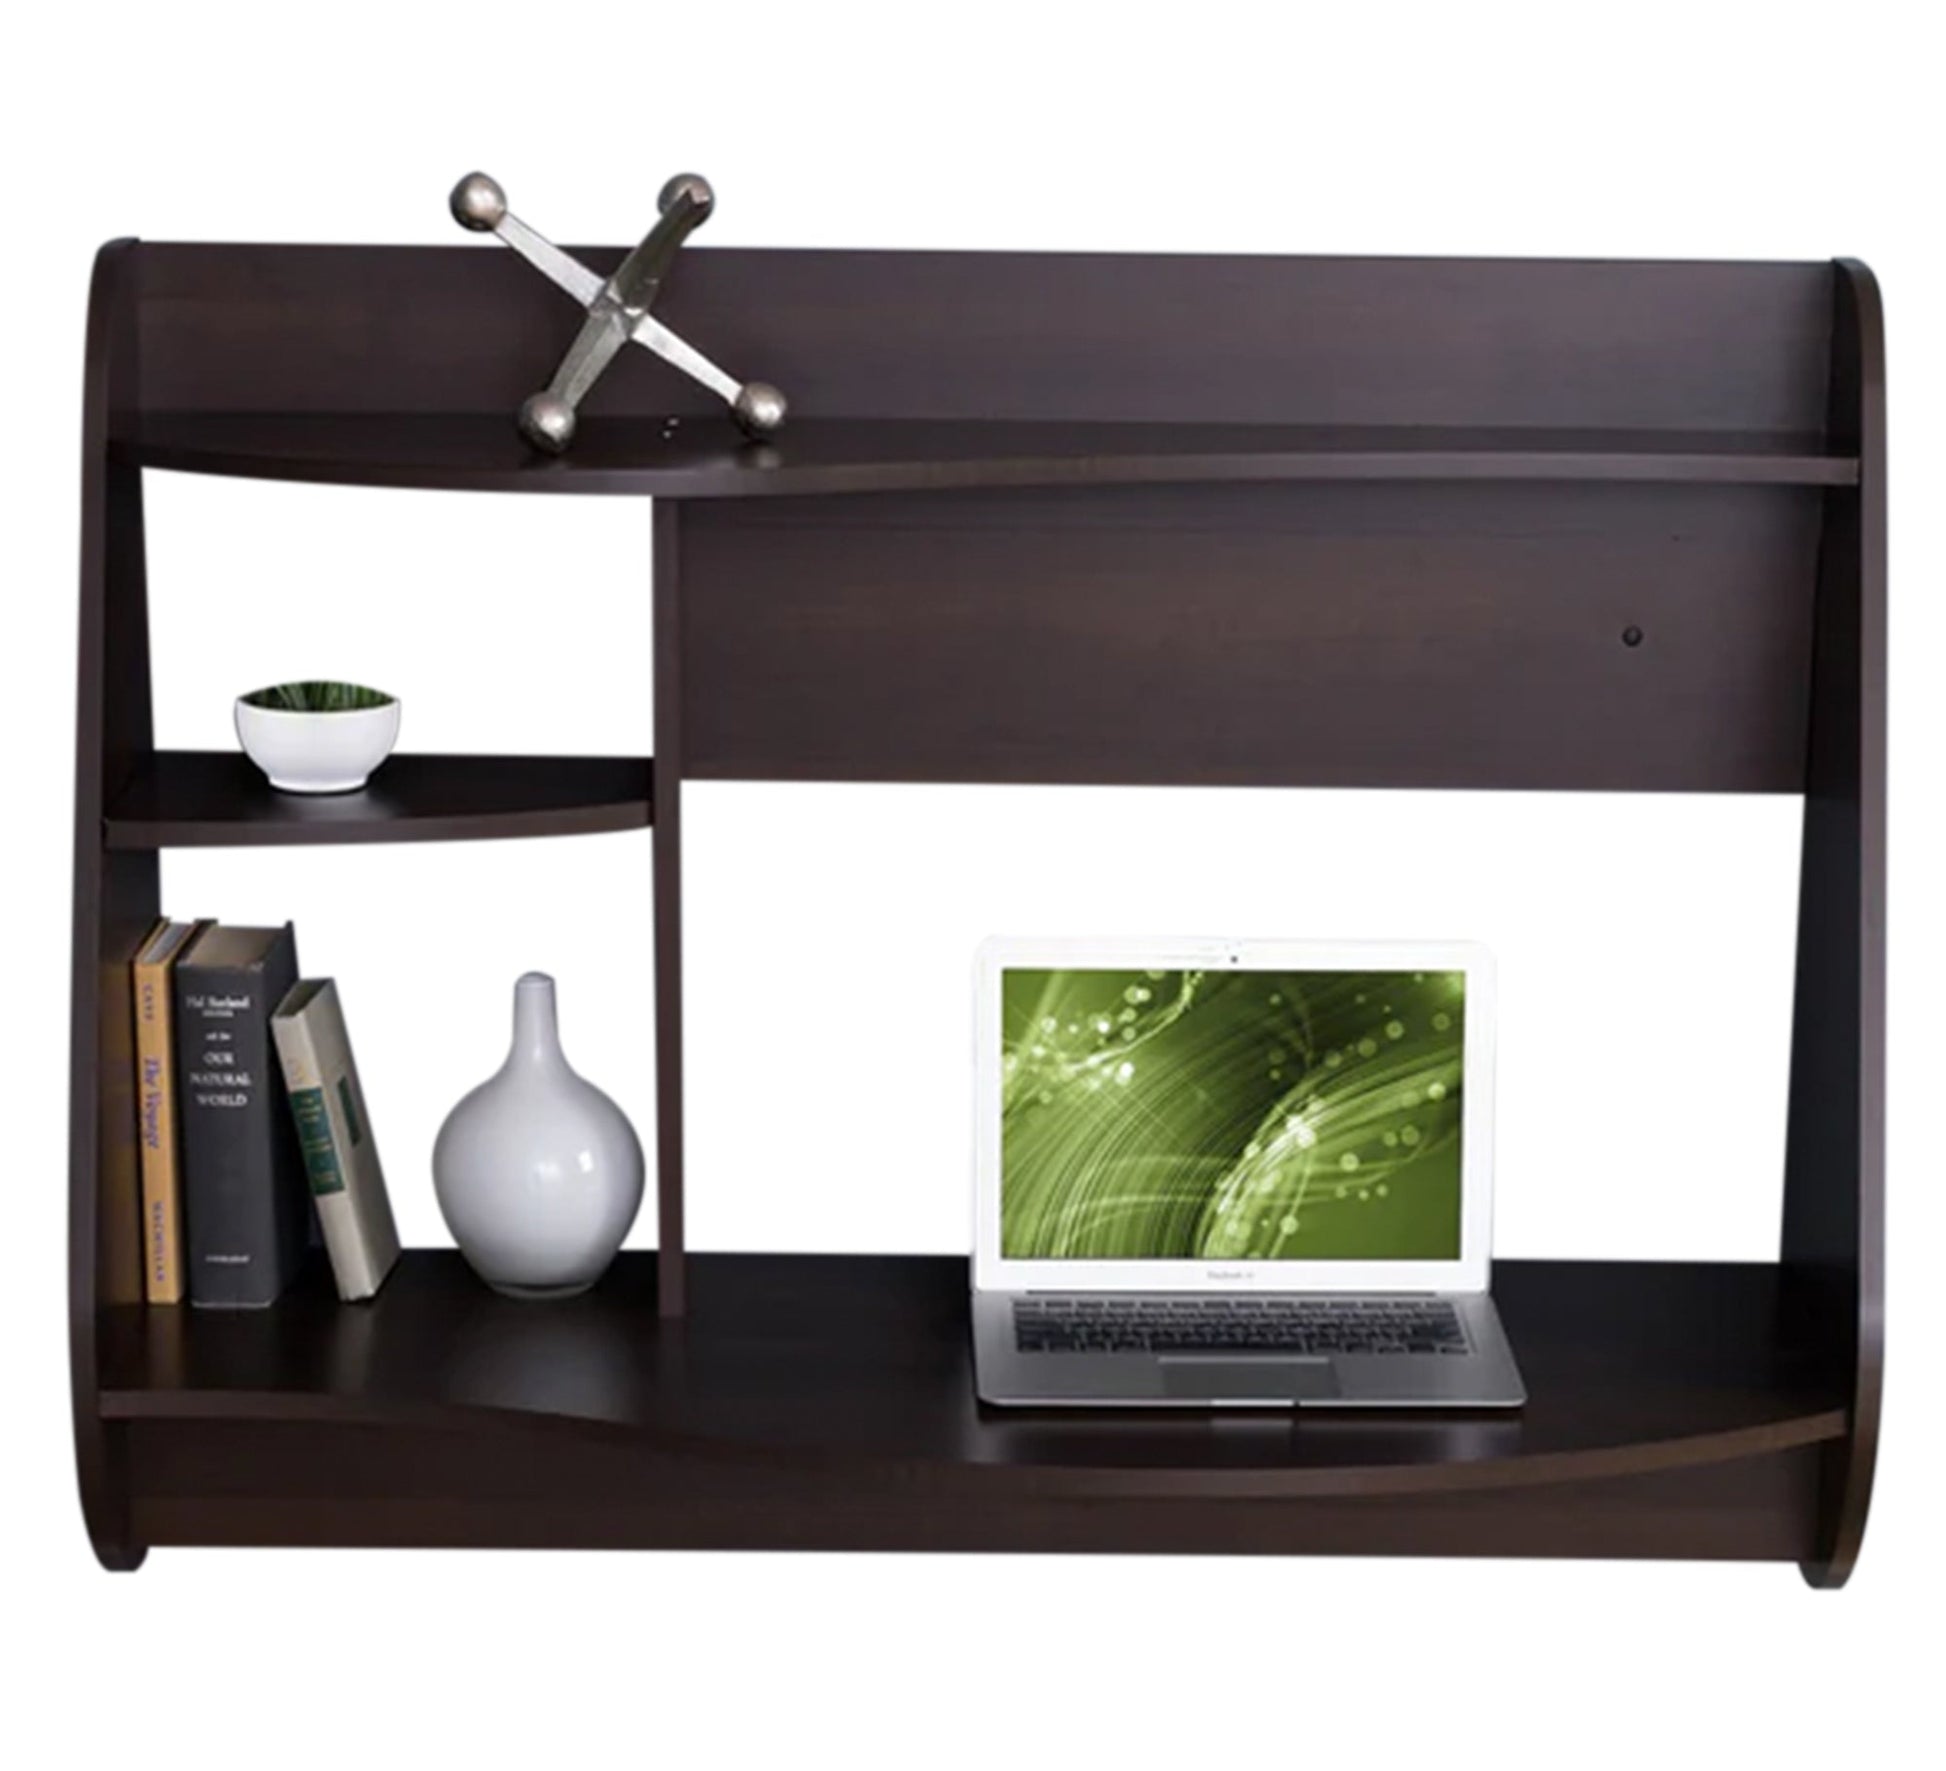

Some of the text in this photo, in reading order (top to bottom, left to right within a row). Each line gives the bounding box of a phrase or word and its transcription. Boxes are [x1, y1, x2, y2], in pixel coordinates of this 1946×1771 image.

[202, 1051, 235, 1066] OUR
[190, 1072, 253, 1087] NATURAL
[196, 1094, 249, 1107] WORLD
